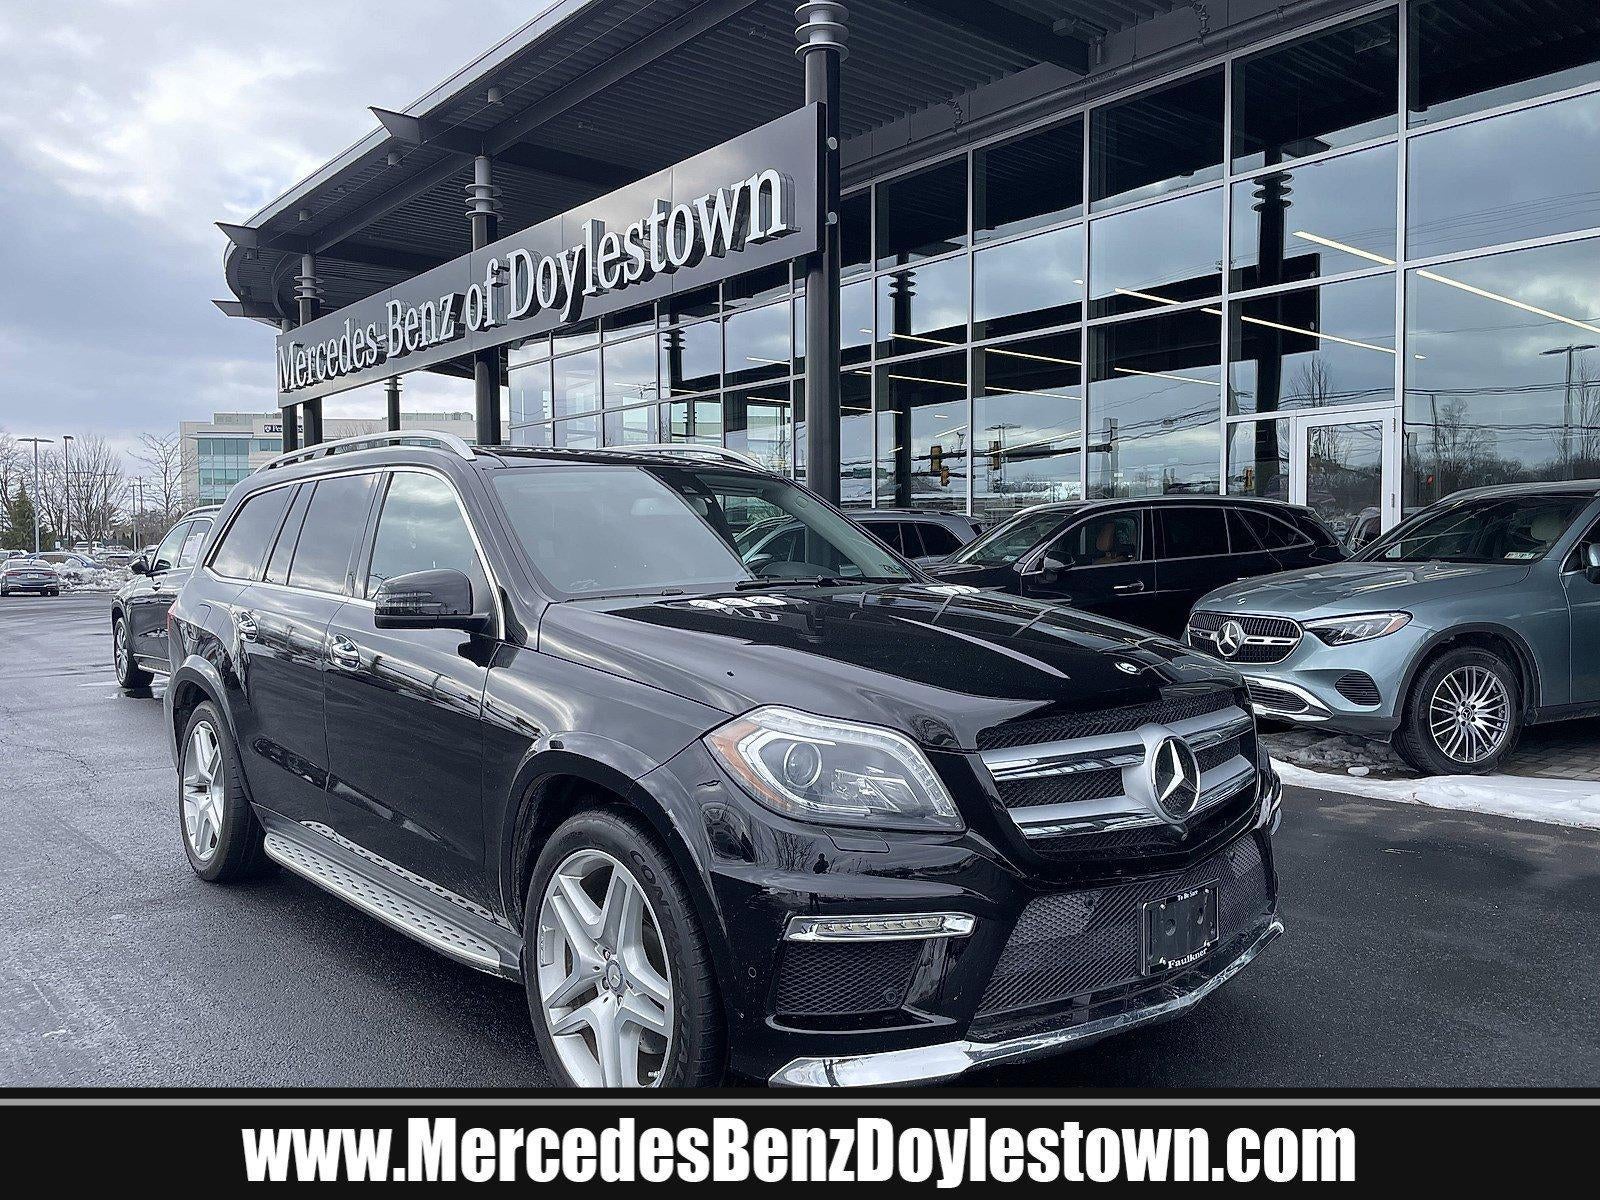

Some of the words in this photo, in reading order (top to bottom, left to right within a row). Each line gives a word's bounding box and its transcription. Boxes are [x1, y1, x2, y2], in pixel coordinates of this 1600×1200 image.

[278, 291, 455, 393] Mercedes-Benz
[464, 258, 498, 332] of
[506, 168, 789, 323] Doylestown
[1167, 948, 1208, 970] Faulkner
